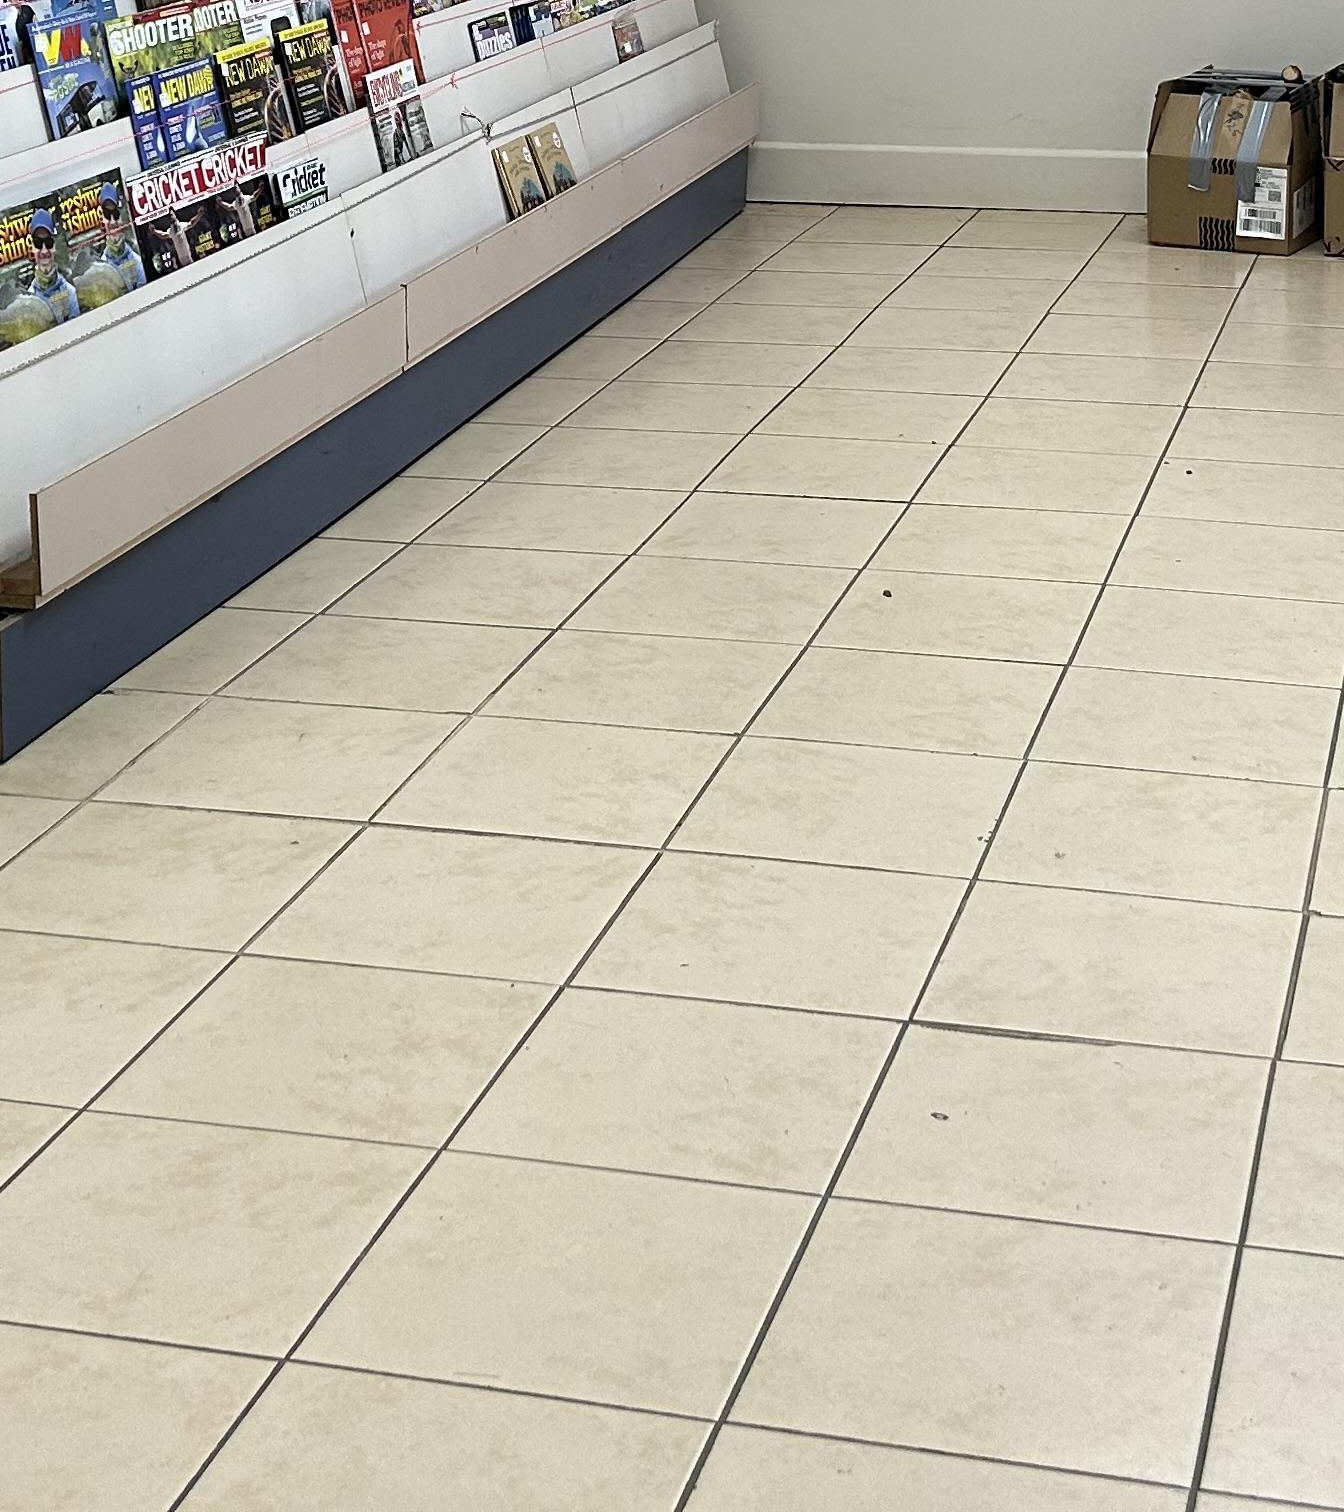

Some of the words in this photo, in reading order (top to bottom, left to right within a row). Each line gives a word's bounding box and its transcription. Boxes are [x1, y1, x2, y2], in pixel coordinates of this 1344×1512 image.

[109, 12, 195, 56] SHOOTER
[131, 160, 200, 215] CRICKET
[200, 138, 267, 188] CRICKET
